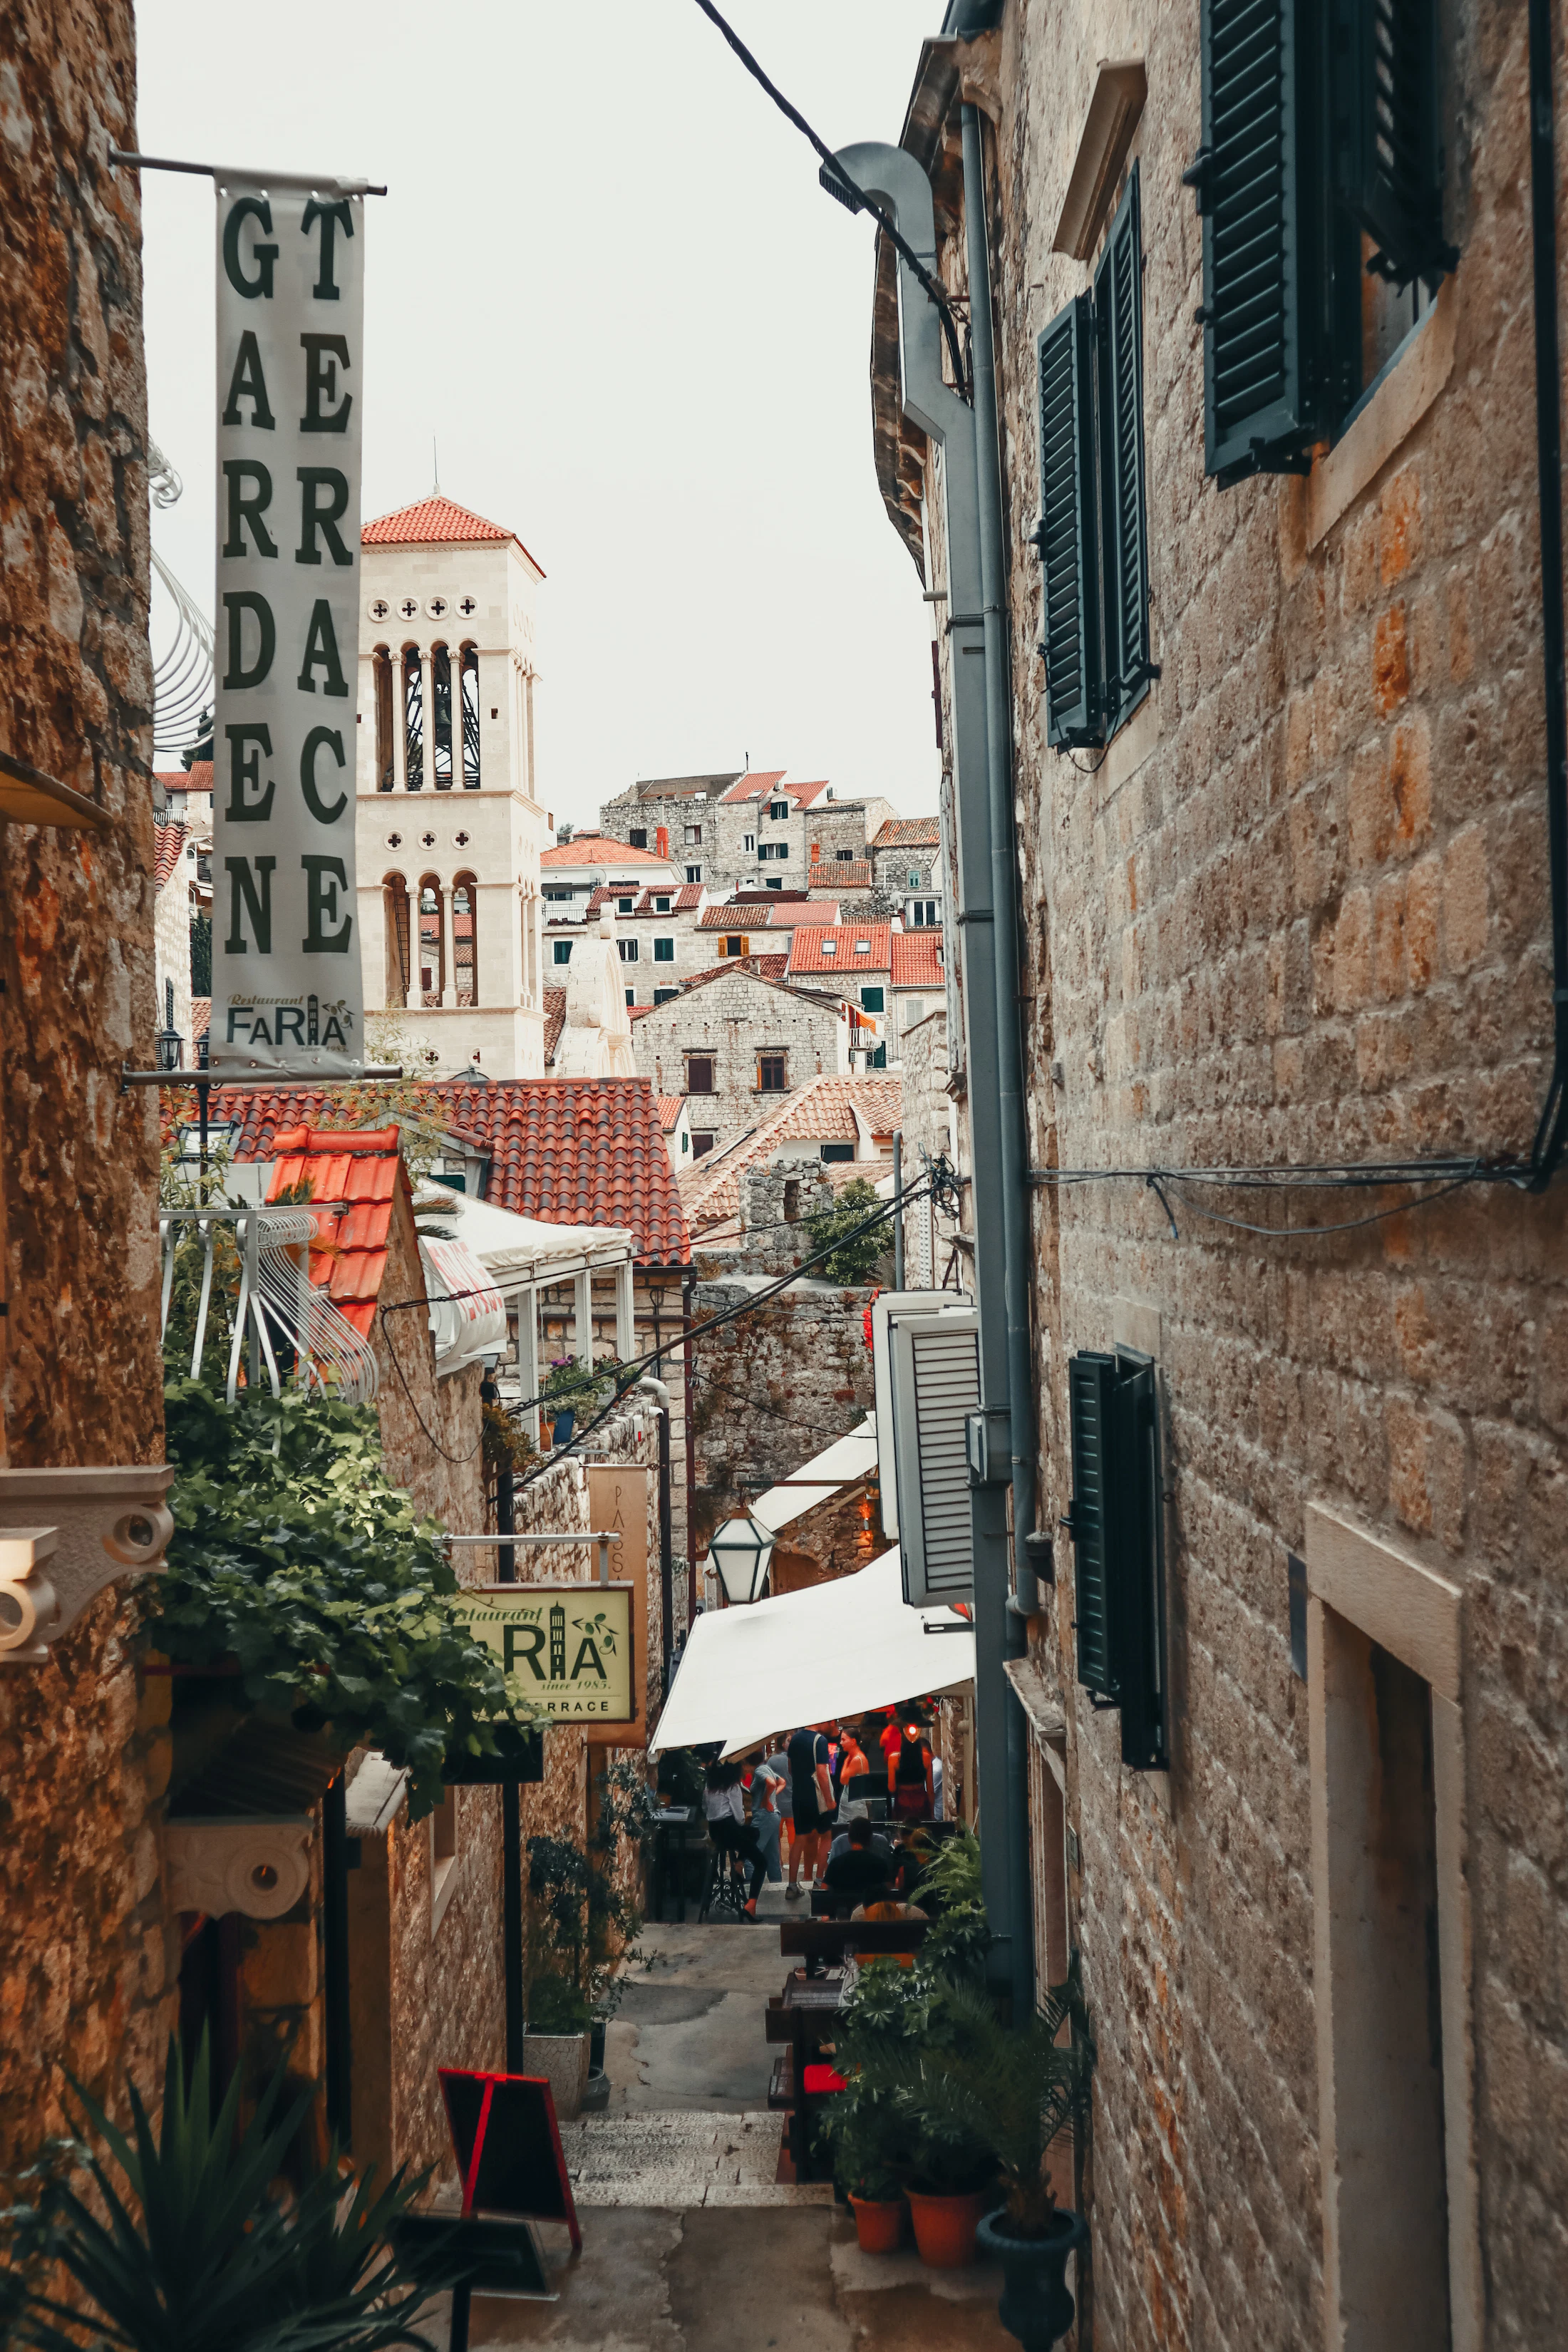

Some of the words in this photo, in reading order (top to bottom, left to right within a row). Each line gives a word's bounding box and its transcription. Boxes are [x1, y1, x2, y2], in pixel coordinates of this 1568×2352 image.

[222, 197, 279, 954] GARDEN
[295, 198, 354, 954] TERRACE
[227, 994, 304, 1005] Restaurant
[541, 1681, 571, 1691] since
